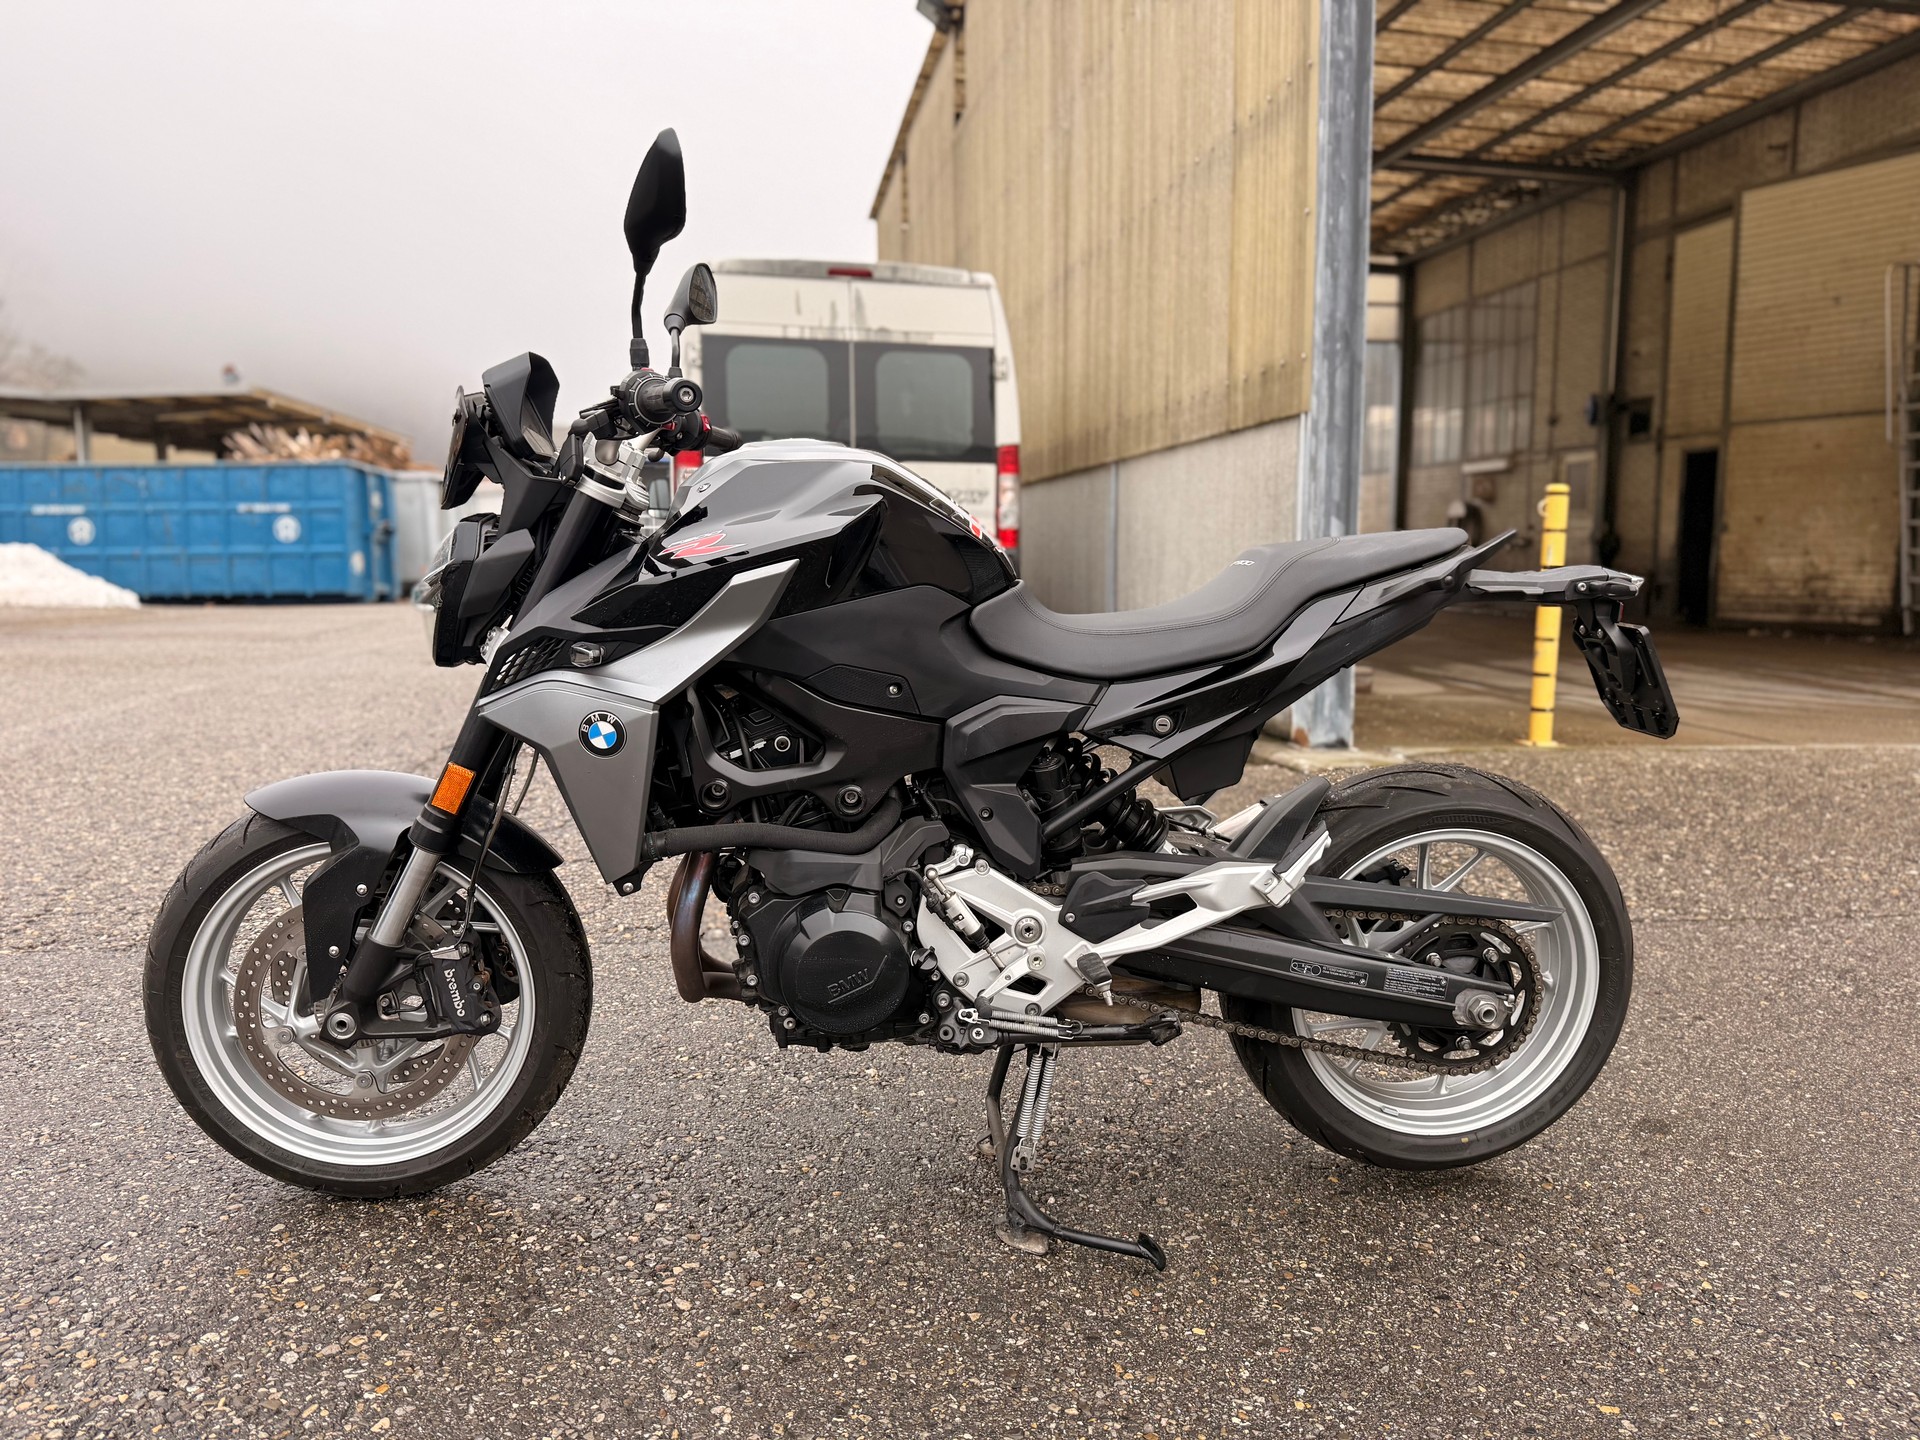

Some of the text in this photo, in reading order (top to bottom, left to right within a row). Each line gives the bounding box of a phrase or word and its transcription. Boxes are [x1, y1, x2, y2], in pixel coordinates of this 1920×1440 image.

[580, 713, 616, 733] BMW
[443, 968, 466, 1017] brembo
[826, 967, 869, 996] BMW
